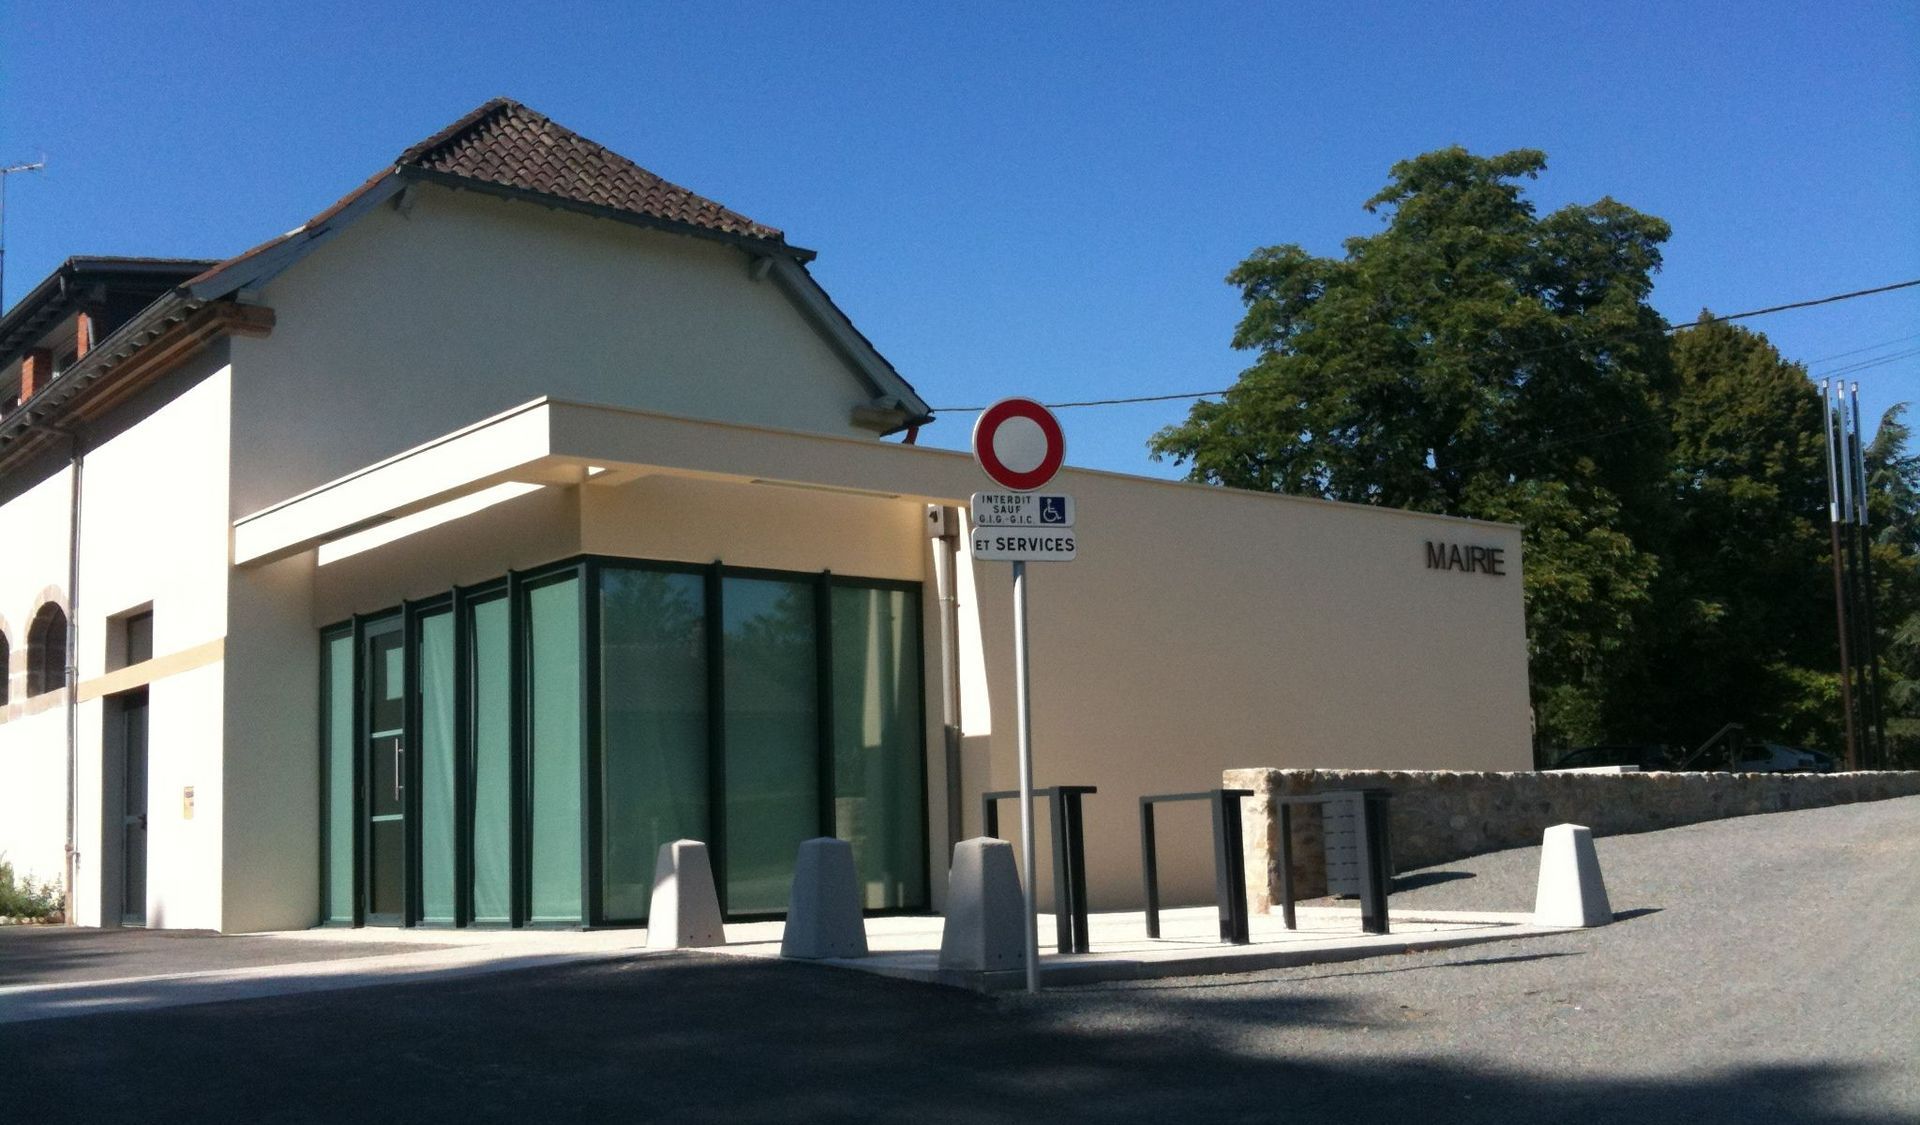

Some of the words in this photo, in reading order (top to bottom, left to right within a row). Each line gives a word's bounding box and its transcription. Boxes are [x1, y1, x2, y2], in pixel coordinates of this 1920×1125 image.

[982, 495, 1031, 504] INTERDIT
[993, 505, 1021, 513] SAUF
[976, 540, 990, 551] ET
[996, 537, 1075, 551] SERVICES
[1426, 541, 1506, 576] MAIRIE
